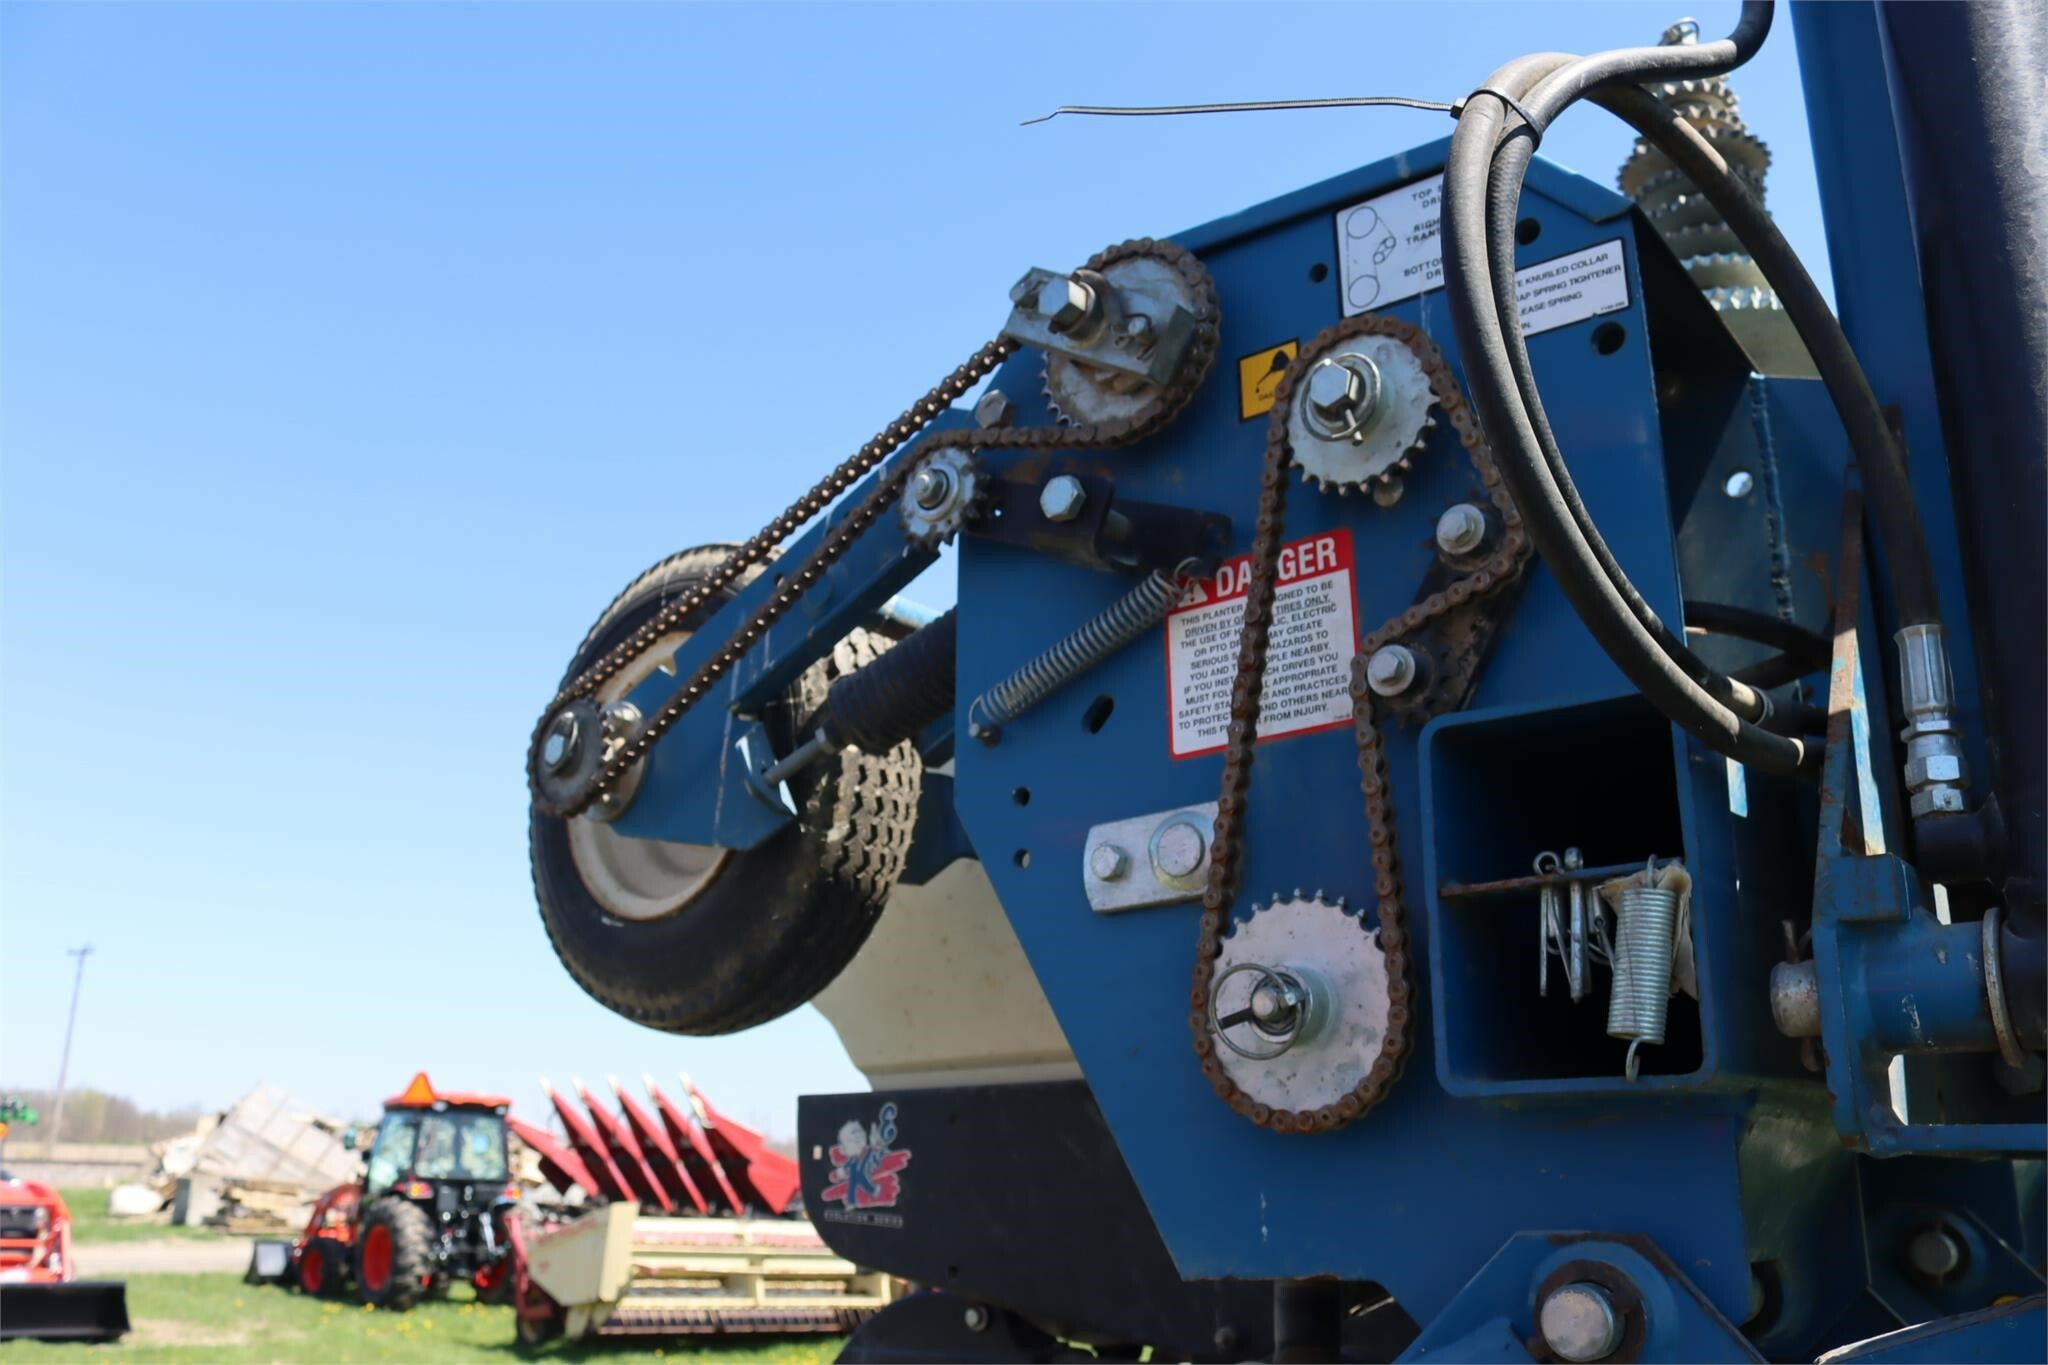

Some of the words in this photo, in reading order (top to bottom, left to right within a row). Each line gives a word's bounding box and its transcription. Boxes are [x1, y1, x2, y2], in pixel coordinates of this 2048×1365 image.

[1412, 188, 1432, 201] TOP
[1413, 217, 1441, 232] RIGH
[1404, 257, 1441, 277] BOTTO
[1533, 281, 1567, 297] SPRING
[1569, 264, 1621, 285] TIGHTENER
[1570, 253, 1609, 271] COLLAR
[1547, 291, 1583, 307] SPRING
[1216, 537, 1337, 597] DAGER
[1181, 615, 1200, 626] THIS
[1202, 604, 1243, 621] PLANTER
[1277, 588, 1303, 601] GNED
[1306, 584, 1318, 594] TO
[1321, 580, 1334, 591] BE
[1185, 622, 1217, 638] DRIVEN
[1220, 619, 1231, 629] BY
[1275, 600, 1302, 615] TIRES
[1181, 639, 1197, 648] THE
[1200, 634, 1217, 644] USE
[1220, 630, 1232, 639] OF
[1291, 603, 1337, 622] ELECTRIC
[1194, 648, 1207, 657] OR
[1210, 643, 1227, 653] PTO
[1286, 619, 1323, 635] CREATE
[1190, 654, 1230, 669] SERIOUS
[1268, 633, 1313, 650] HAZARDS
[1316, 630, 1328, 639] TO
[1190, 670, 1208, 681] YOU
[1210, 665, 1229, 676] AND
[1265, 651, 1288, 663] OPLE
[1184, 686, 1191, 695] IF
[1194, 682, 1213, 692] YOU
[1214, 676, 1235, 688] INST
[1281, 657, 1316, 672] DRIVES
[1318, 652, 1339, 663] YOU
[1186, 692, 1210, 705] MUST
[1272, 664, 1338, 686] APPROPRIATE
[1179, 704, 1212, 719] SAFETY
[1271, 687, 1291, 698] AND
[1294, 674, 1348, 693] PRACTICES
[1179, 720, 1191, 730] TO
[1193, 711, 1231, 727] PROTEC
[1280, 692, 1319, 709] OTHERS
[1197, 726, 1217, 737] THIS
[1264, 710, 1291, 723] FROM
